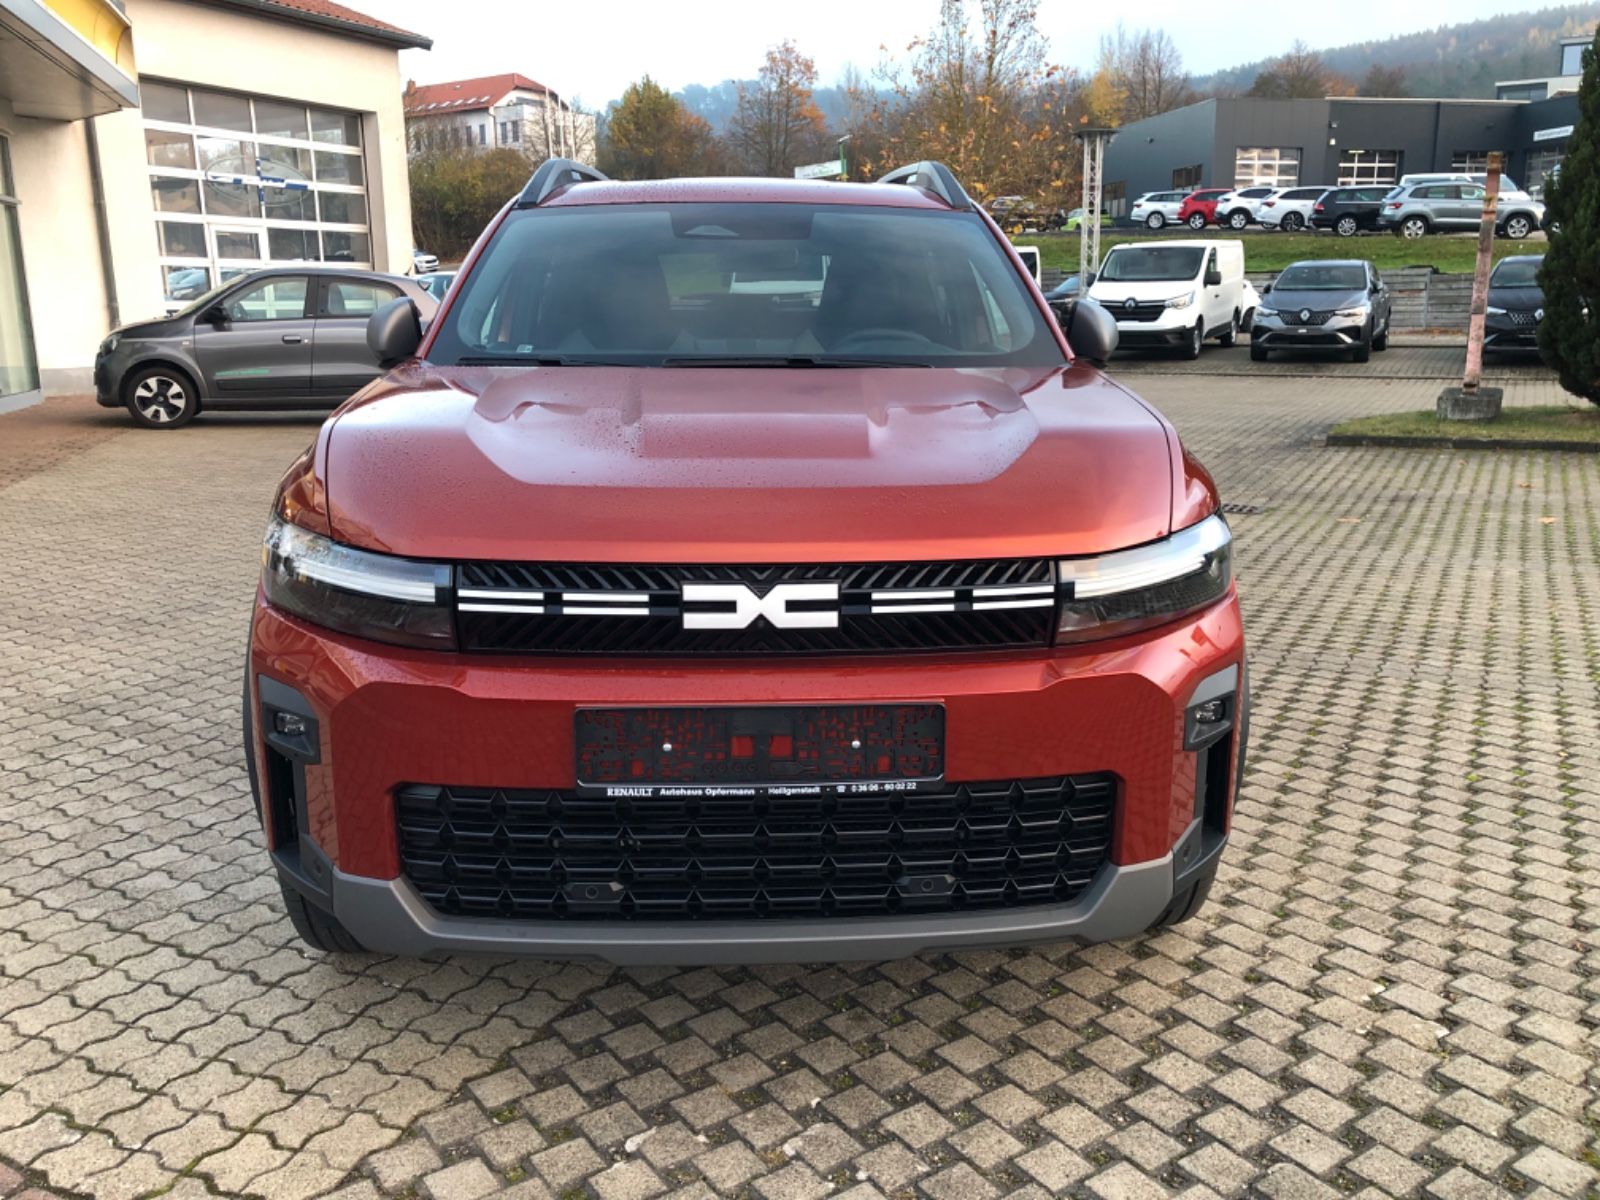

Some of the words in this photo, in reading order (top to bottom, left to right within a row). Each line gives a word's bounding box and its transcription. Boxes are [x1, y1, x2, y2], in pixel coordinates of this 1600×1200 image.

[607, 788, 653, 797] RENAULT
[660, 788, 703, 796] Autohaus
[705, 788, 755, 797] Opfermann
